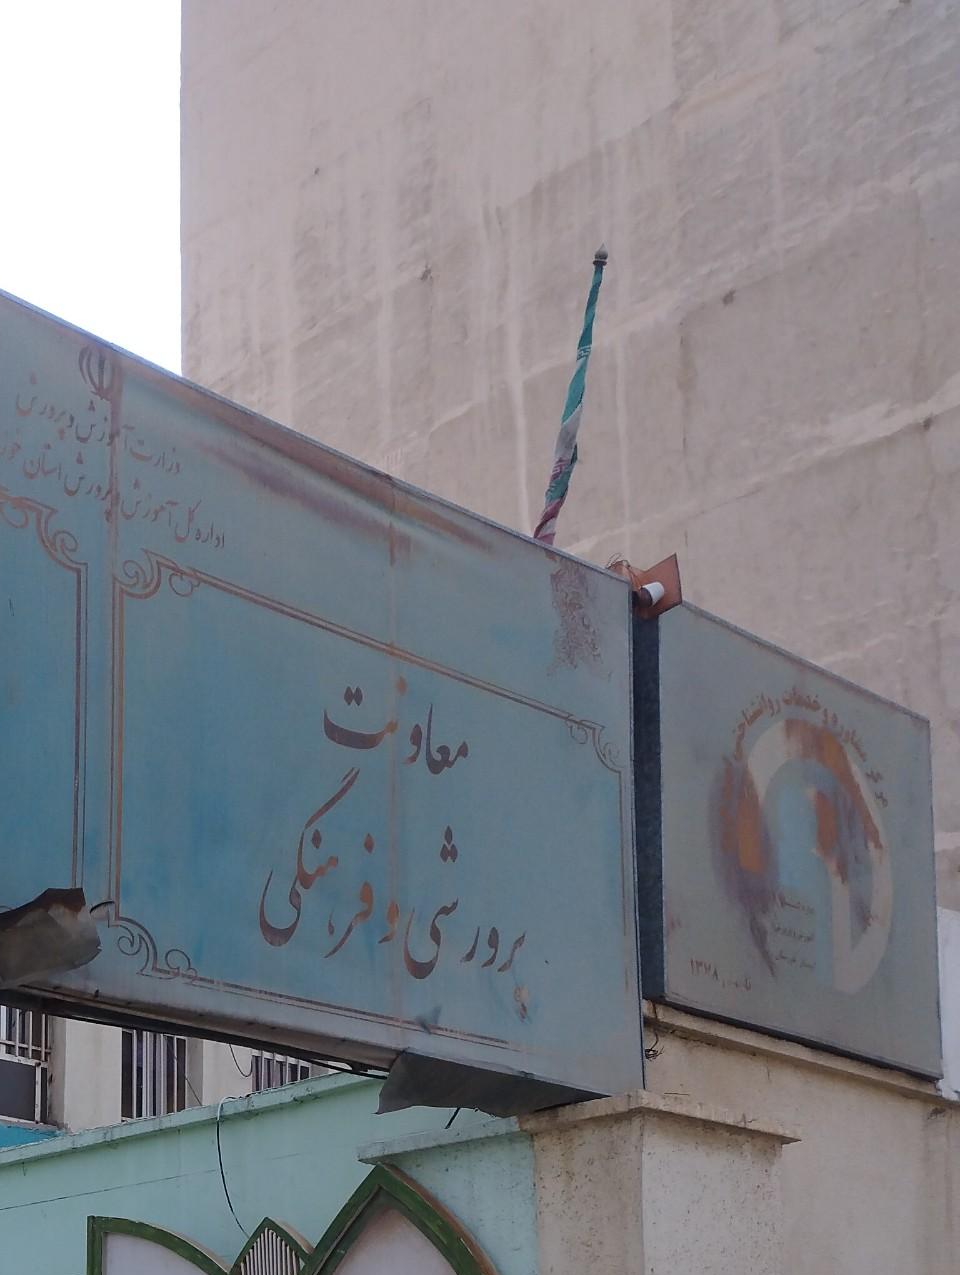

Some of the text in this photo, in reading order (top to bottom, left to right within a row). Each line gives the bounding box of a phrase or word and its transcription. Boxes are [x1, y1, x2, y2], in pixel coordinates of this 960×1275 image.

[23, 443, 62, 480] استان
[129, 439, 181, 475] وزارت
[120, 478, 179, 528] آموزش
[174, 499, 202, 544] کل
[194, 520, 225, 549] اداره
[323, 675, 469, 775] معاونت
[259, 766, 531, 1022] پرورشی و فرهنگی
